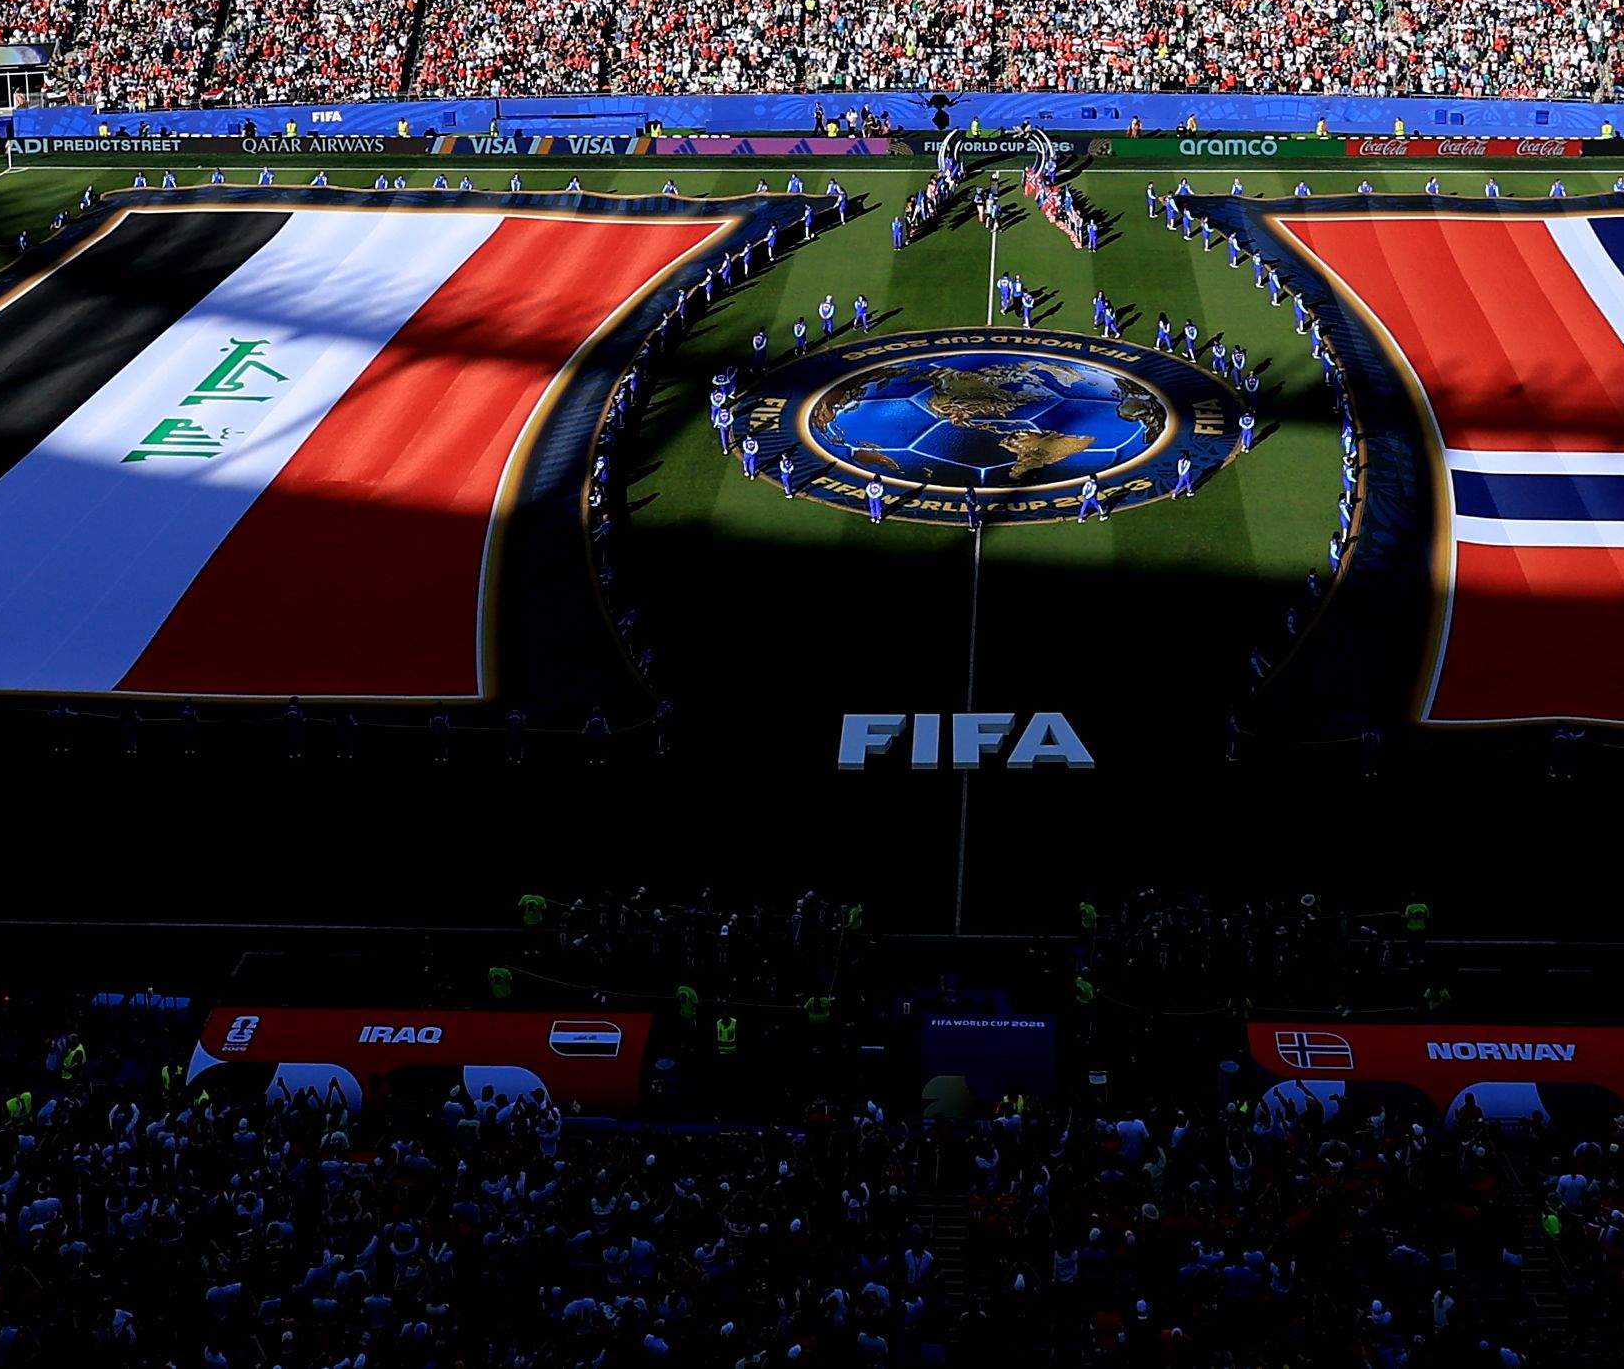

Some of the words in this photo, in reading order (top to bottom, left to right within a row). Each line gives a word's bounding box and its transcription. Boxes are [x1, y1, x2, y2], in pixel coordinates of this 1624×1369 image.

[312, 110, 343, 123] FIFA
[8, 138, 48, 154] ADI
[54, 139, 182, 152] PREDICTSTREET
[242, 138, 302, 154] QATAR
[308, 138, 385, 153] AIRWAYS
[471, 137, 518, 154] VISA
[567, 137, 615, 154] VISA
[1000, 141, 1025, 151] CUP
[1179, 138, 1278, 156] aramco
[934, 335, 982, 346] CUP
[990, 336, 1083, 350] WORLD
[841, 339, 930, 361] 2026
[1089, 344, 1142, 363] FIFA
[1192, 398, 1225, 435] FIFA
[811, 476, 866, 500] FIFA
[987, 500, 1049, 512] CUP
[838, 712, 1095, 770] FIFA
[931, 1019, 953, 1027] FIFA
[357, 1025, 443, 1044] IRAQ
[1426, 1041, 1577, 1061] NORWAY
